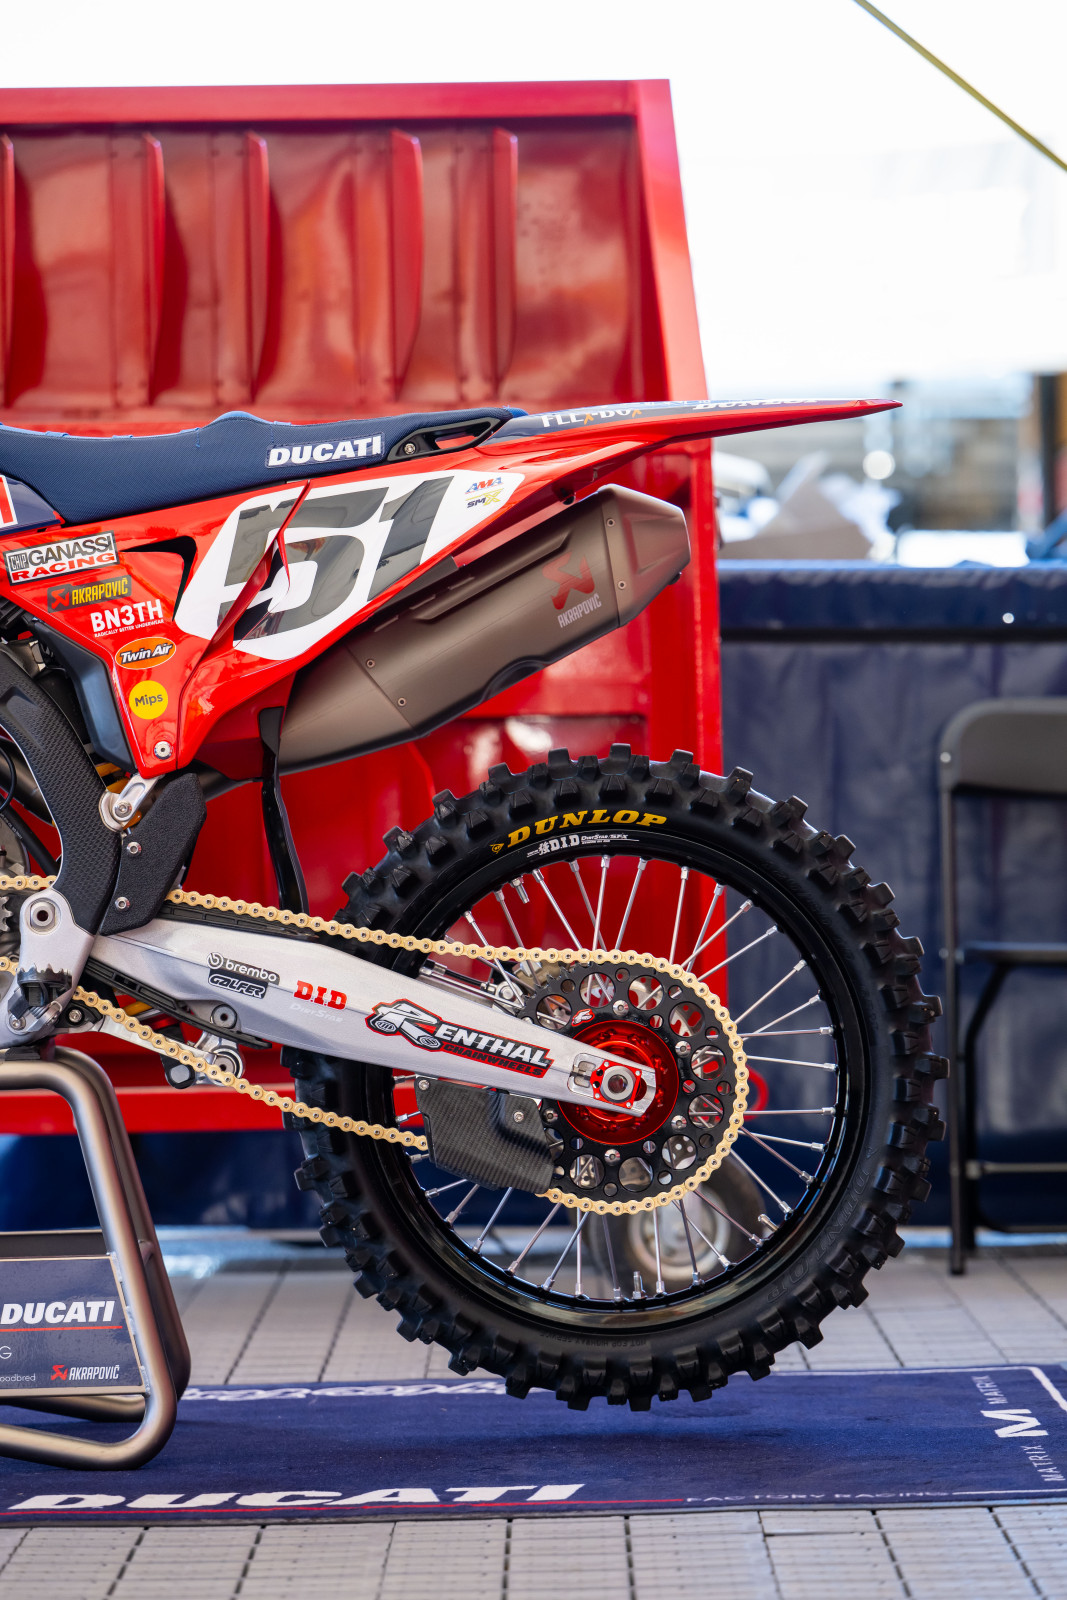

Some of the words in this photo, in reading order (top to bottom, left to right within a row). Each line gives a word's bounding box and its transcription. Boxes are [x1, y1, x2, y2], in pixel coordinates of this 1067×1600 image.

[268, 436, 381, 466] DUCATI
[466, 477, 502, 493] AMA
[10, 553, 28, 571] CHIP
[29, 536, 113, 566] GANASSI
[12, 553, 115, 581] RACING
[217, 475, 454, 641] 51
[72, 578, 128, 605] AKRAPOVIČ
[91, 599, 163, 632] BN3TH
[121, 648, 150, 664] Twin
[152, 643, 173, 657] Air
[135, 694, 163, 707] Mips
[507, 809, 667, 848] DUNLOP
[550, 834, 580, 852] D.I.D
[225, 960, 277, 982] brembo
[209, 975, 265, 998] GALFER
[294, 980, 347, 1010] D.I.D
[443, 1044, 544, 1076] CHAINWHEELS
[1, 1301, 115, 1324] DUCATI
[69, 1365, 120, 1380] AKRAPOVIČ
[980, 1409, 1048, 1438] M
[1020, 1445, 1066, 1481] MATRIX
[8, 1483, 585, 1510] DUCATI
